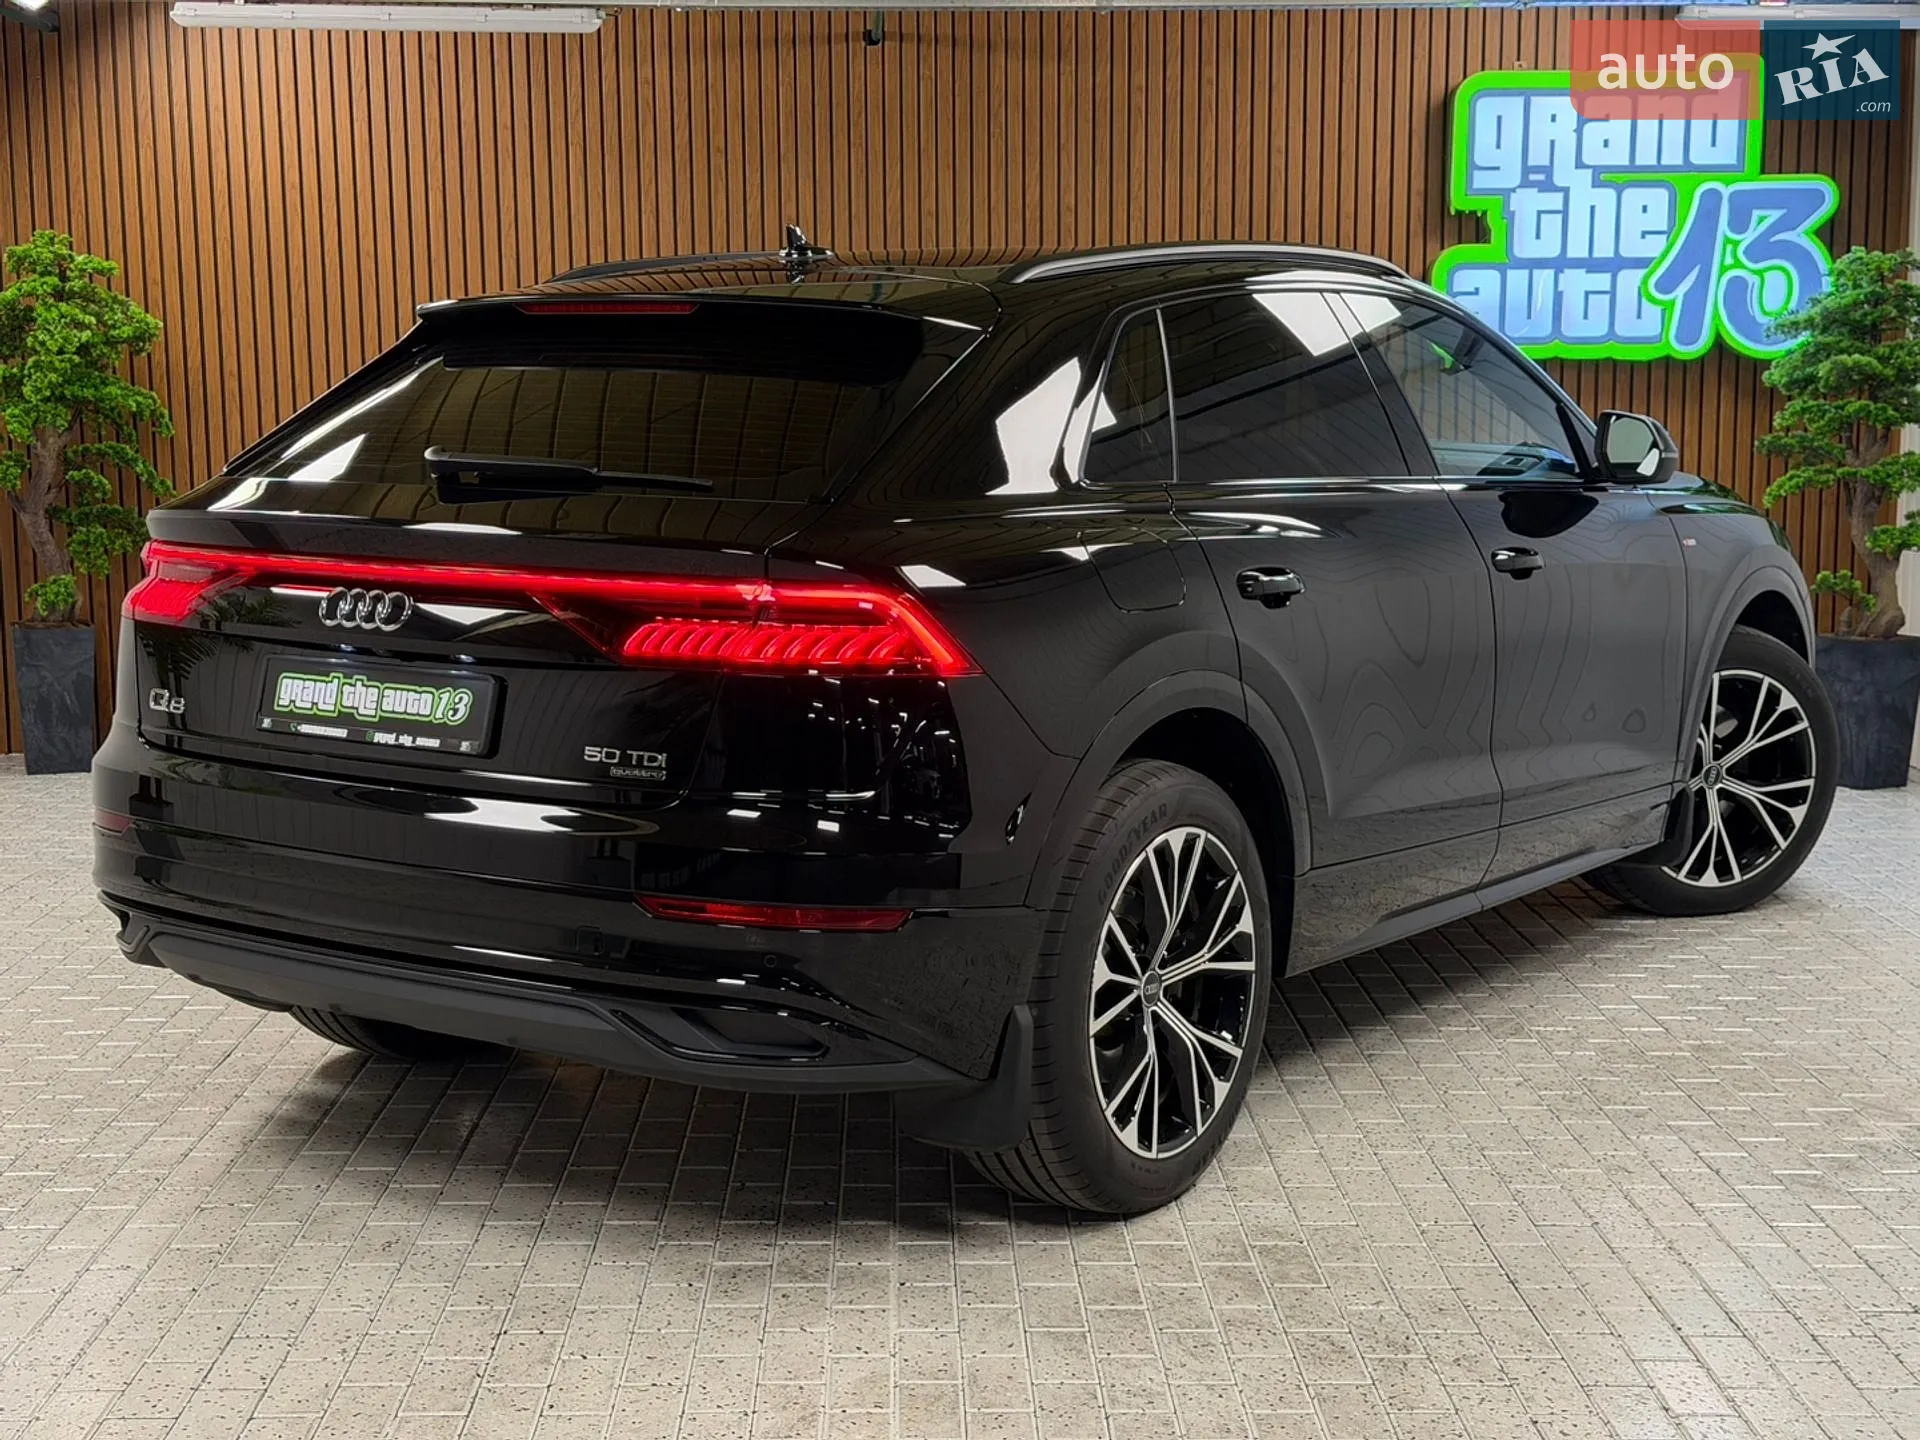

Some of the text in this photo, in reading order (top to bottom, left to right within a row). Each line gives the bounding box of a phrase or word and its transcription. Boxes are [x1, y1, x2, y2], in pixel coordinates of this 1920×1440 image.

[1509, 168, 1671, 260] the
[1452, 181, 1833, 352] auto 13
[149, 687, 185, 714] Q8
[341, 679, 379, 716] the
[381, 688, 434, 716] auto
[434, 690, 470, 721] 13
[583, 746, 668, 768] 50 TDI
